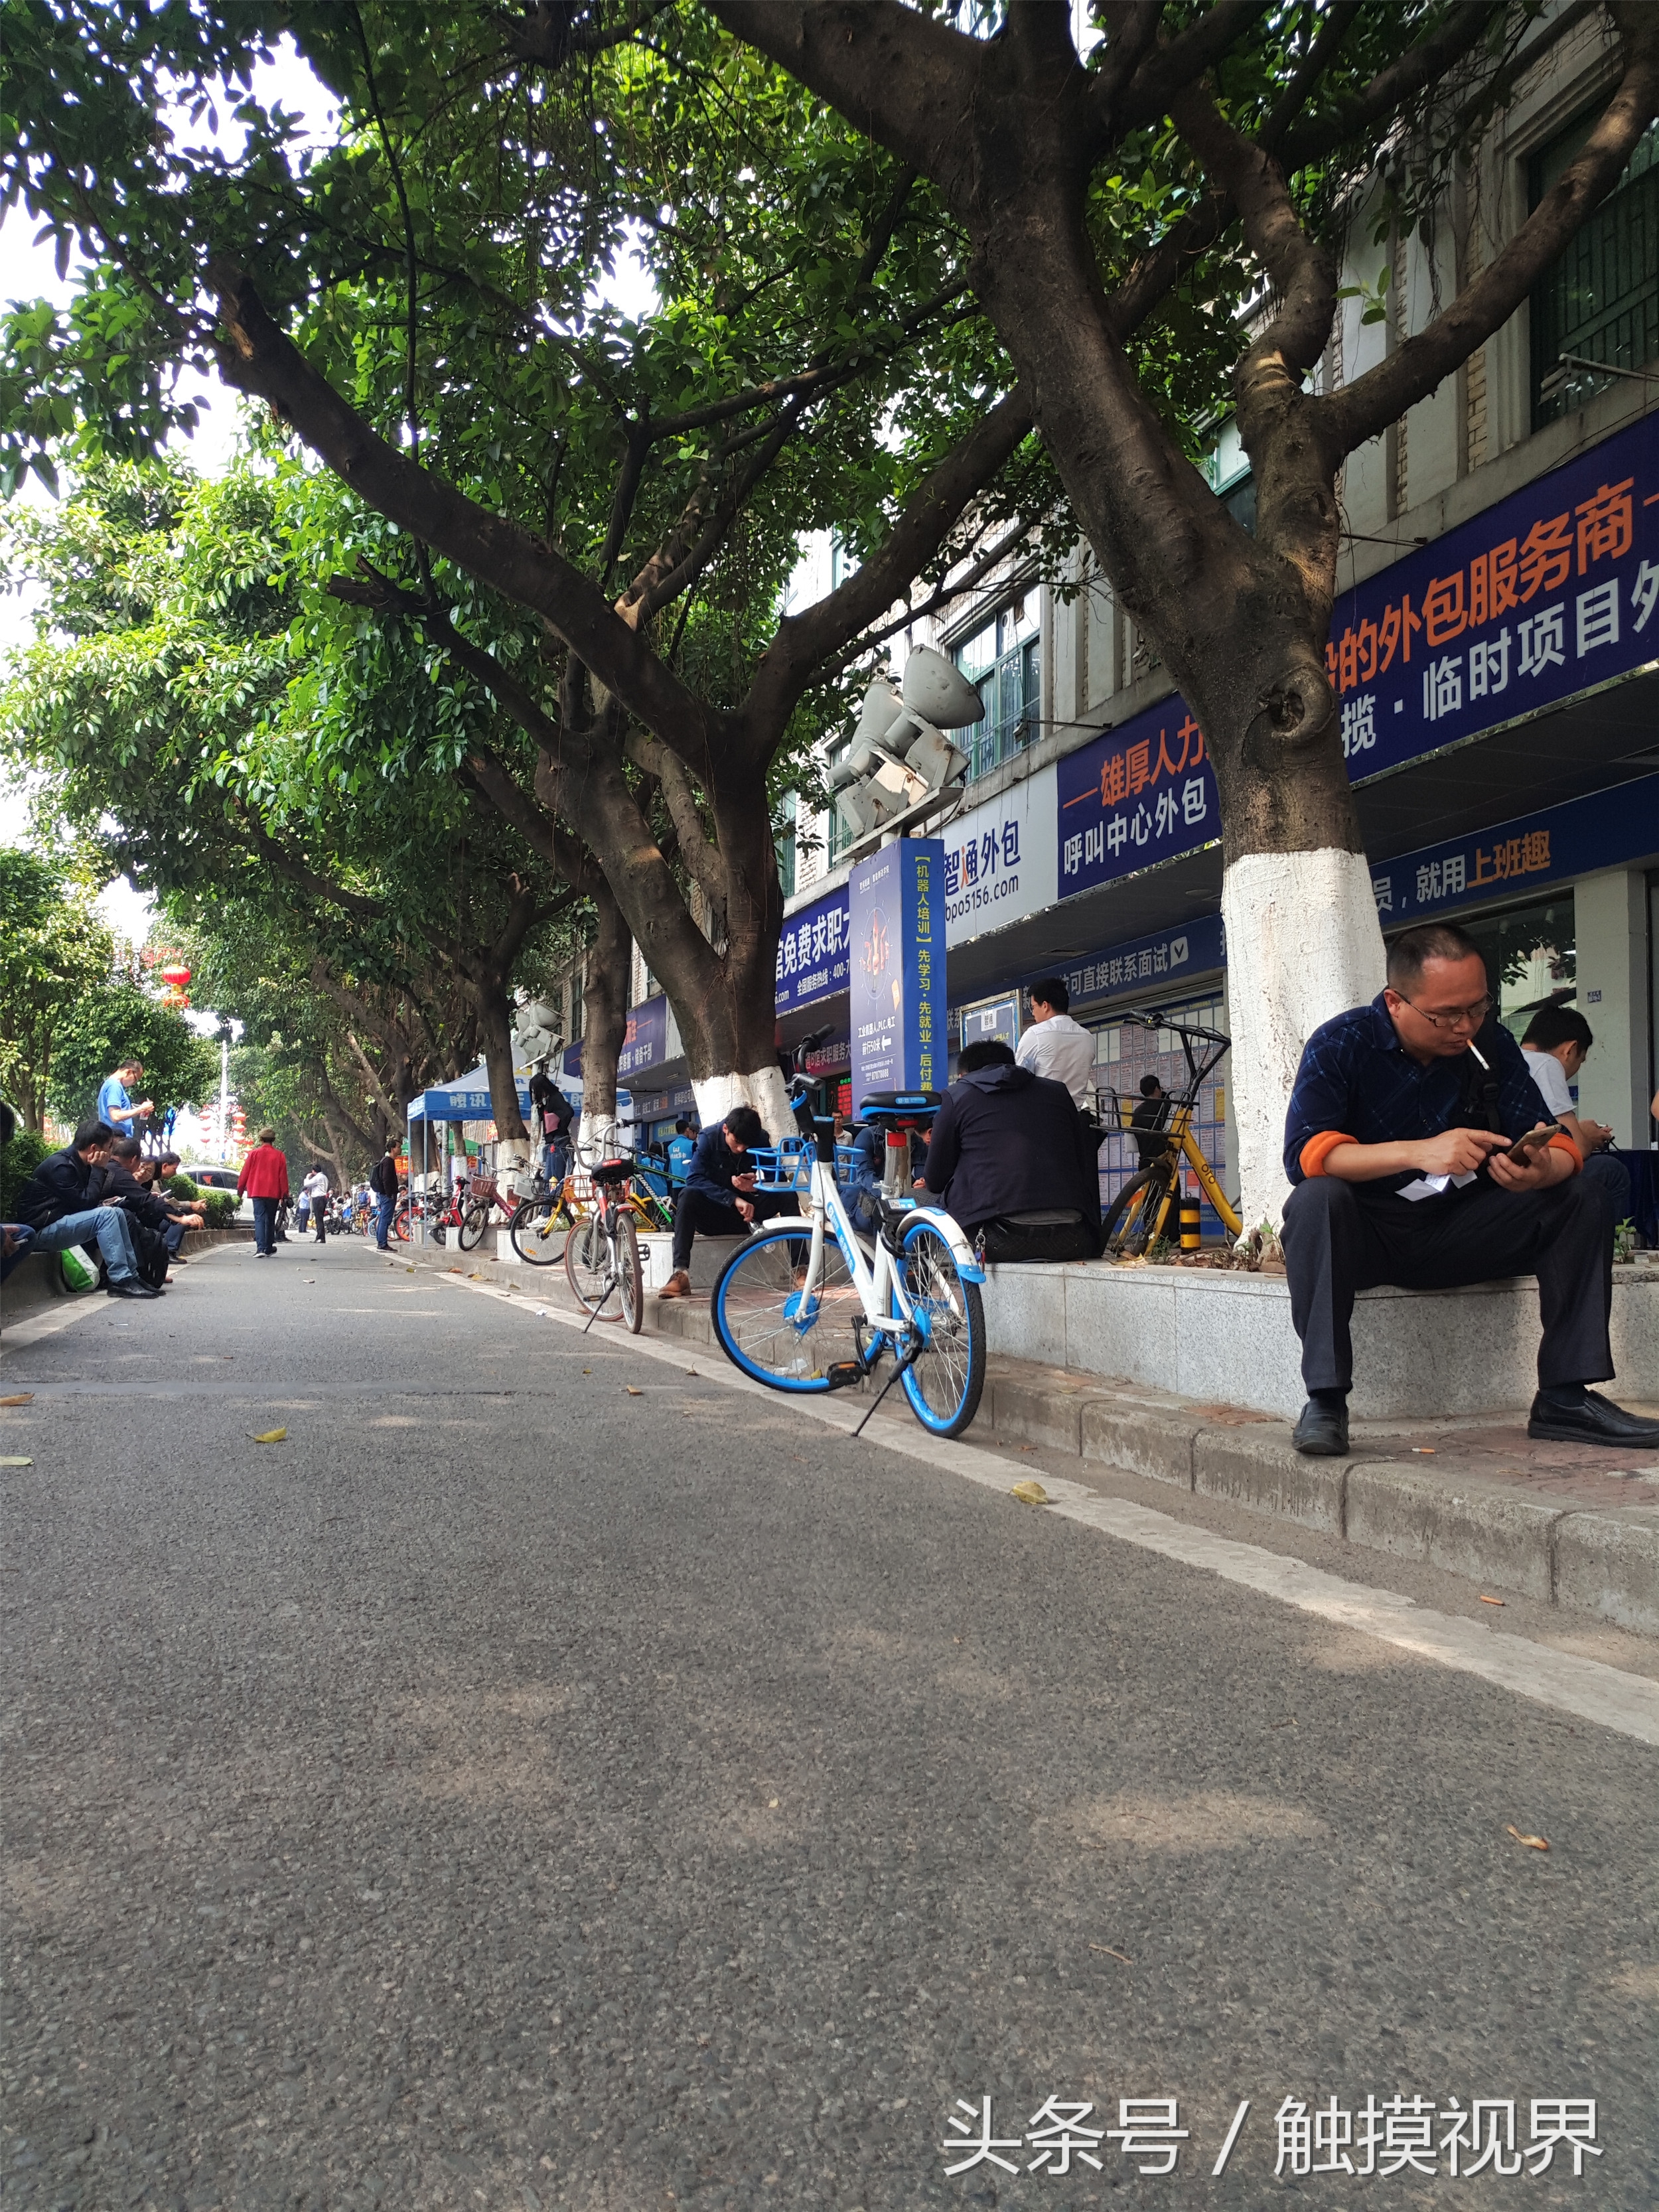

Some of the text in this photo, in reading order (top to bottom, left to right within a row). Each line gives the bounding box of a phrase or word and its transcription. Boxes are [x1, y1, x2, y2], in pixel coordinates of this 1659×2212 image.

[944, 820, 1021, 896] 智通外包
[1064, 776, 1206, 875] 呼叫中心外包
